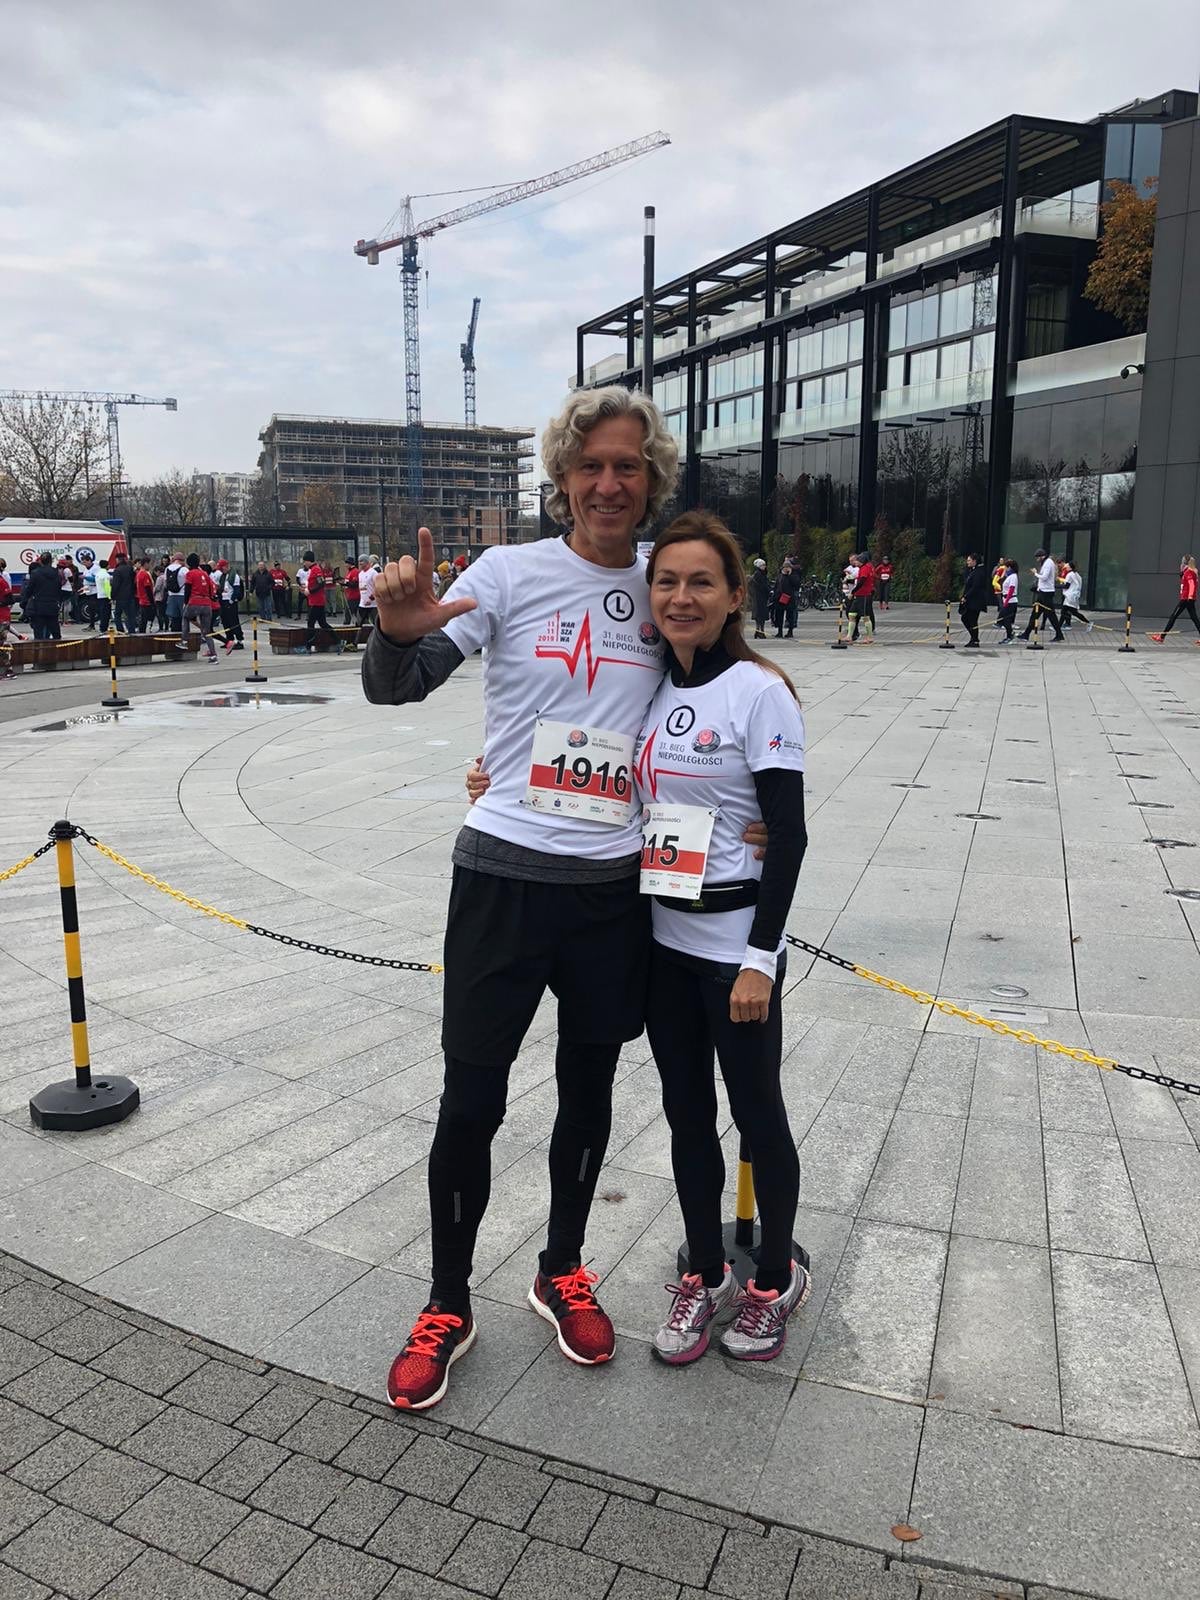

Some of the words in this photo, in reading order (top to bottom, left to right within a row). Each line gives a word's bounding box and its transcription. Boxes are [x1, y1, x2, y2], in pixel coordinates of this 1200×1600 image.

[560, 621, 576, 629] WAR
[560, 628, 573, 636] SZA
[550, 753, 628, 796] 1916
